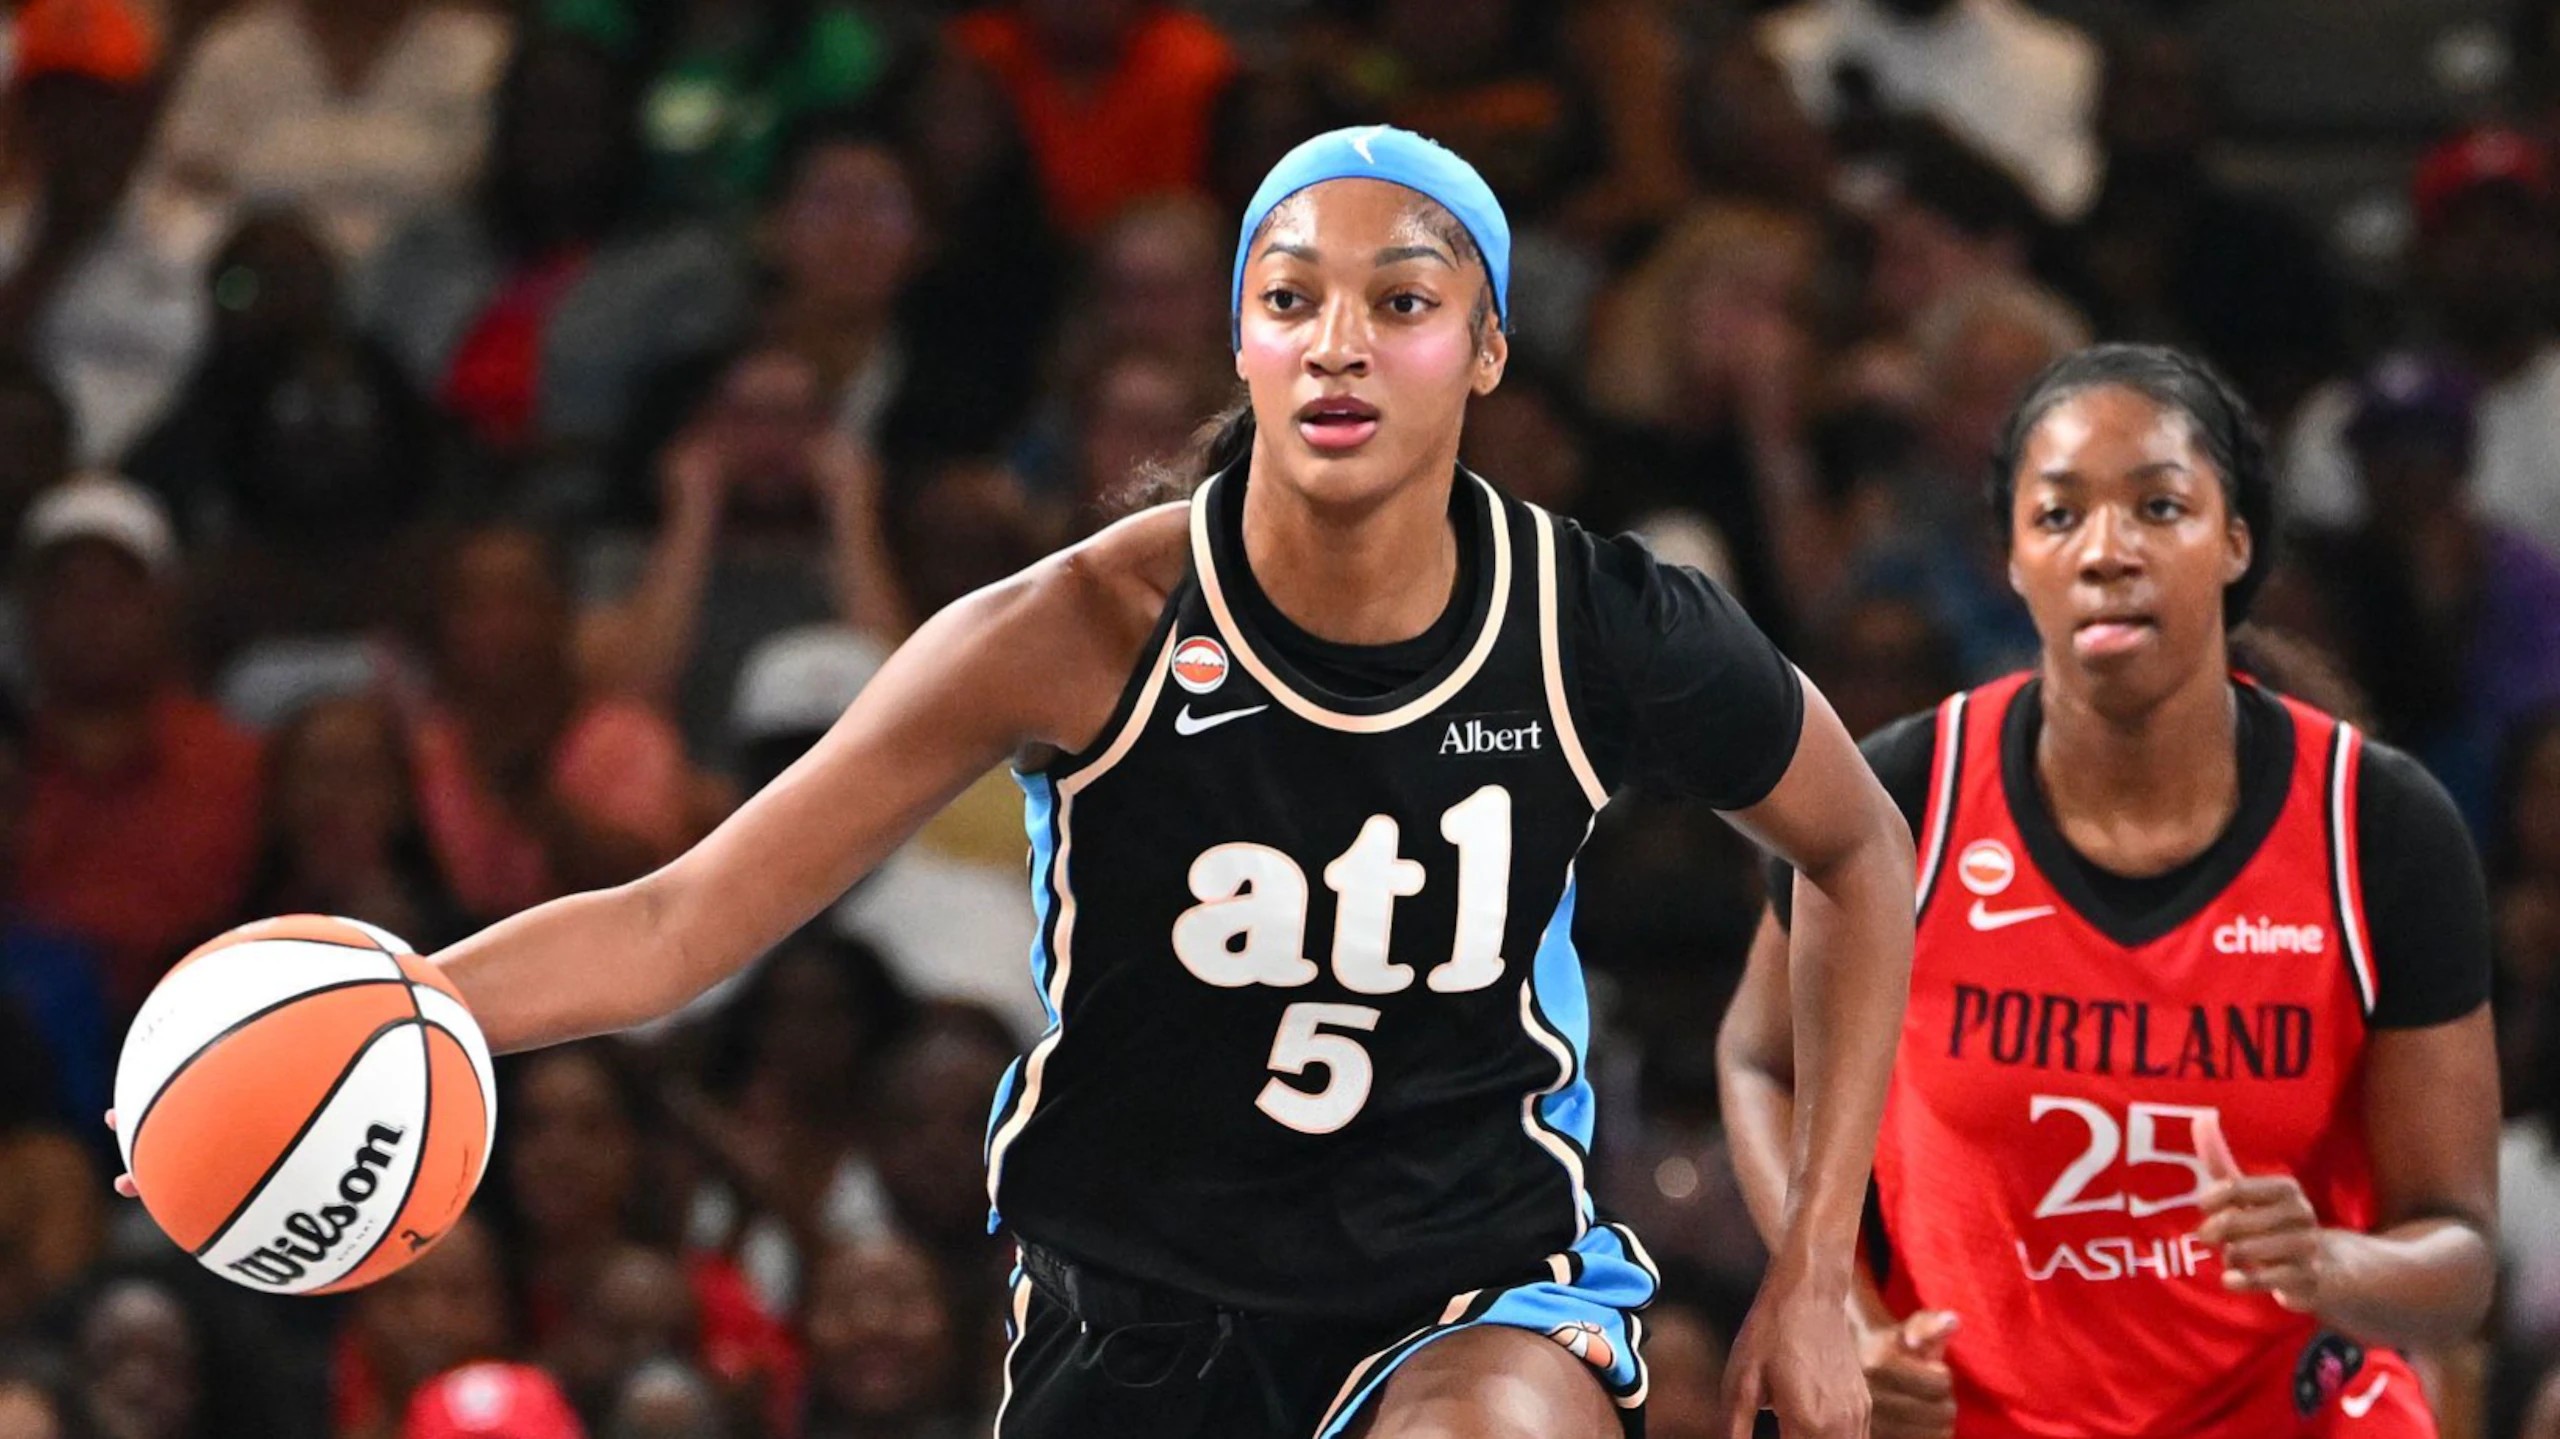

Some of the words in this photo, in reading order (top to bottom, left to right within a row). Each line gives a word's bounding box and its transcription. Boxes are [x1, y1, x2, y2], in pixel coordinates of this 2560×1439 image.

[1438, 719, 1542, 755] Albert
[1171, 783, 1513, 995] atl
[2213, 914, 2324, 954] chime
[1254, 1001, 1382, 1135] 5
[1949, 983, 2313, 1080] PORTLAND
[226, 1122, 404, 1286] Wilson
[2029, 1093, 2219, 1219] 25
[2015, 1232, 2212, 1281] LASHIF
